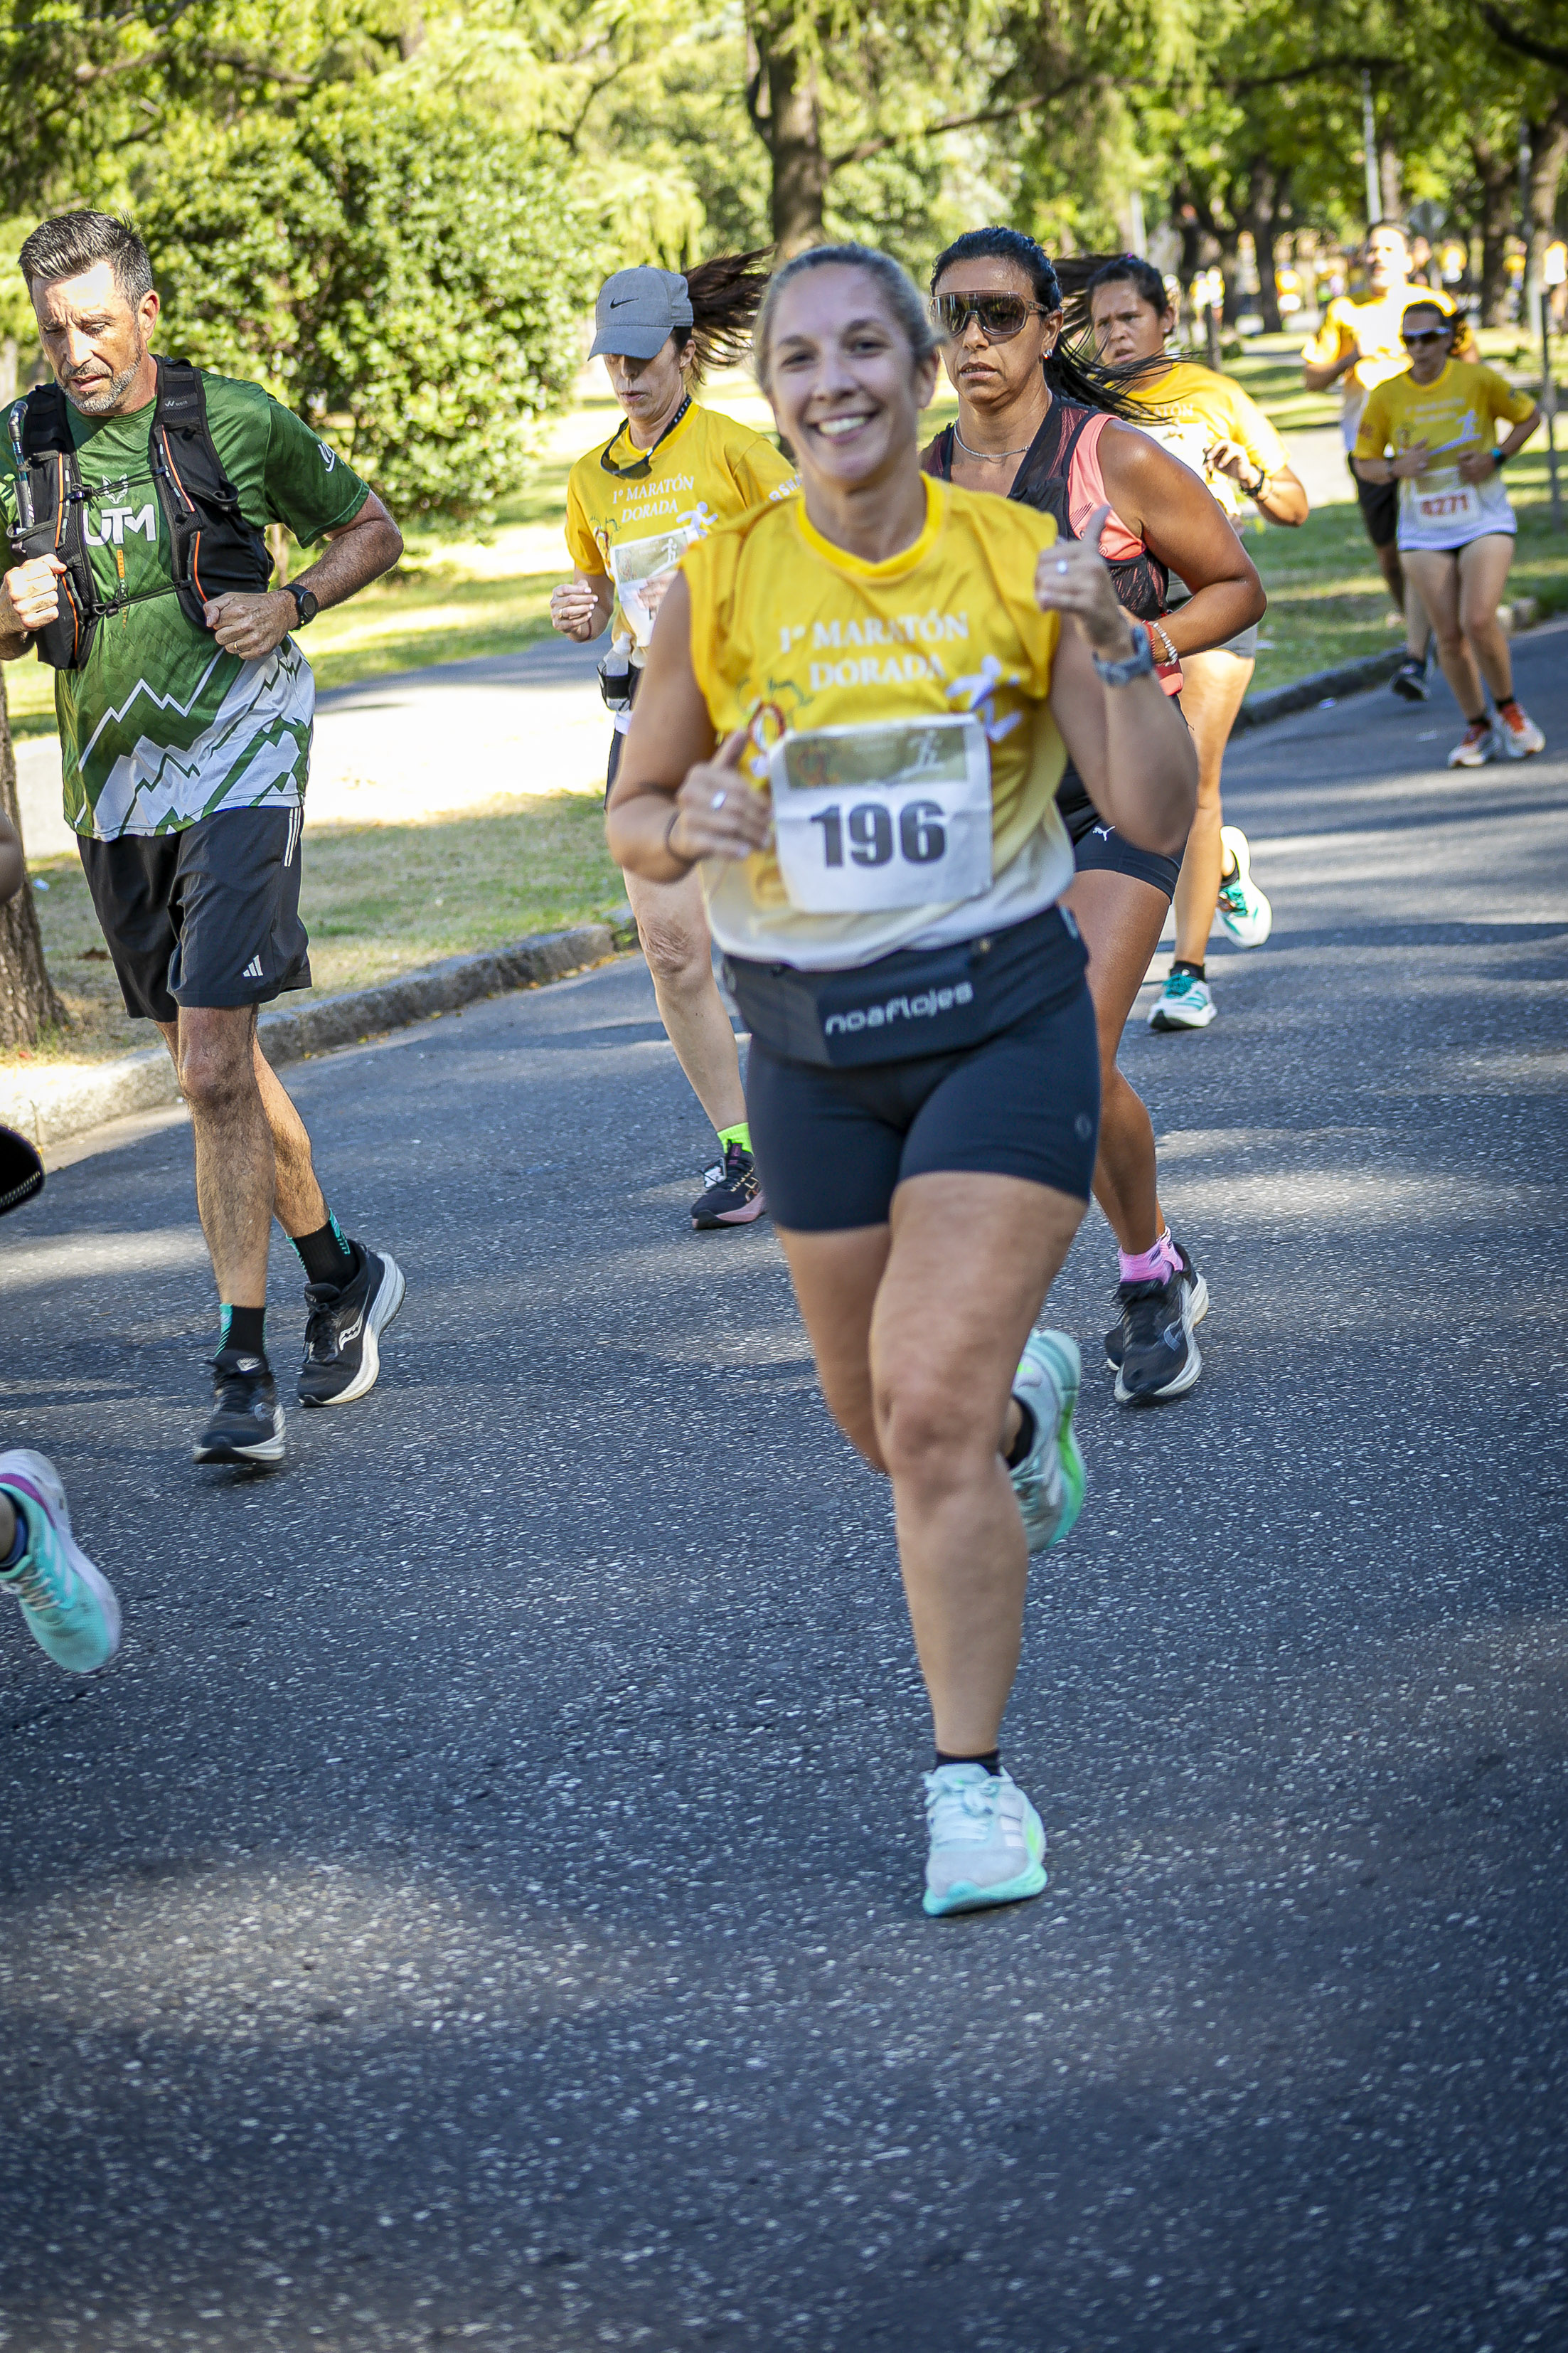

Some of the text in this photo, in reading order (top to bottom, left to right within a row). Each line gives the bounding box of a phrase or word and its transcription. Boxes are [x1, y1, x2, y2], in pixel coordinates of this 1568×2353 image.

[626, 472, 694, 501] MARATÓN
[82, 504, 156, 546] UTM
[621, 499, 678, 523] DORADA
[812, 607, 969, 650] MARATÓN
[809, 653, 946, 691] DORADA
[810, 801, 946, 868] 196
